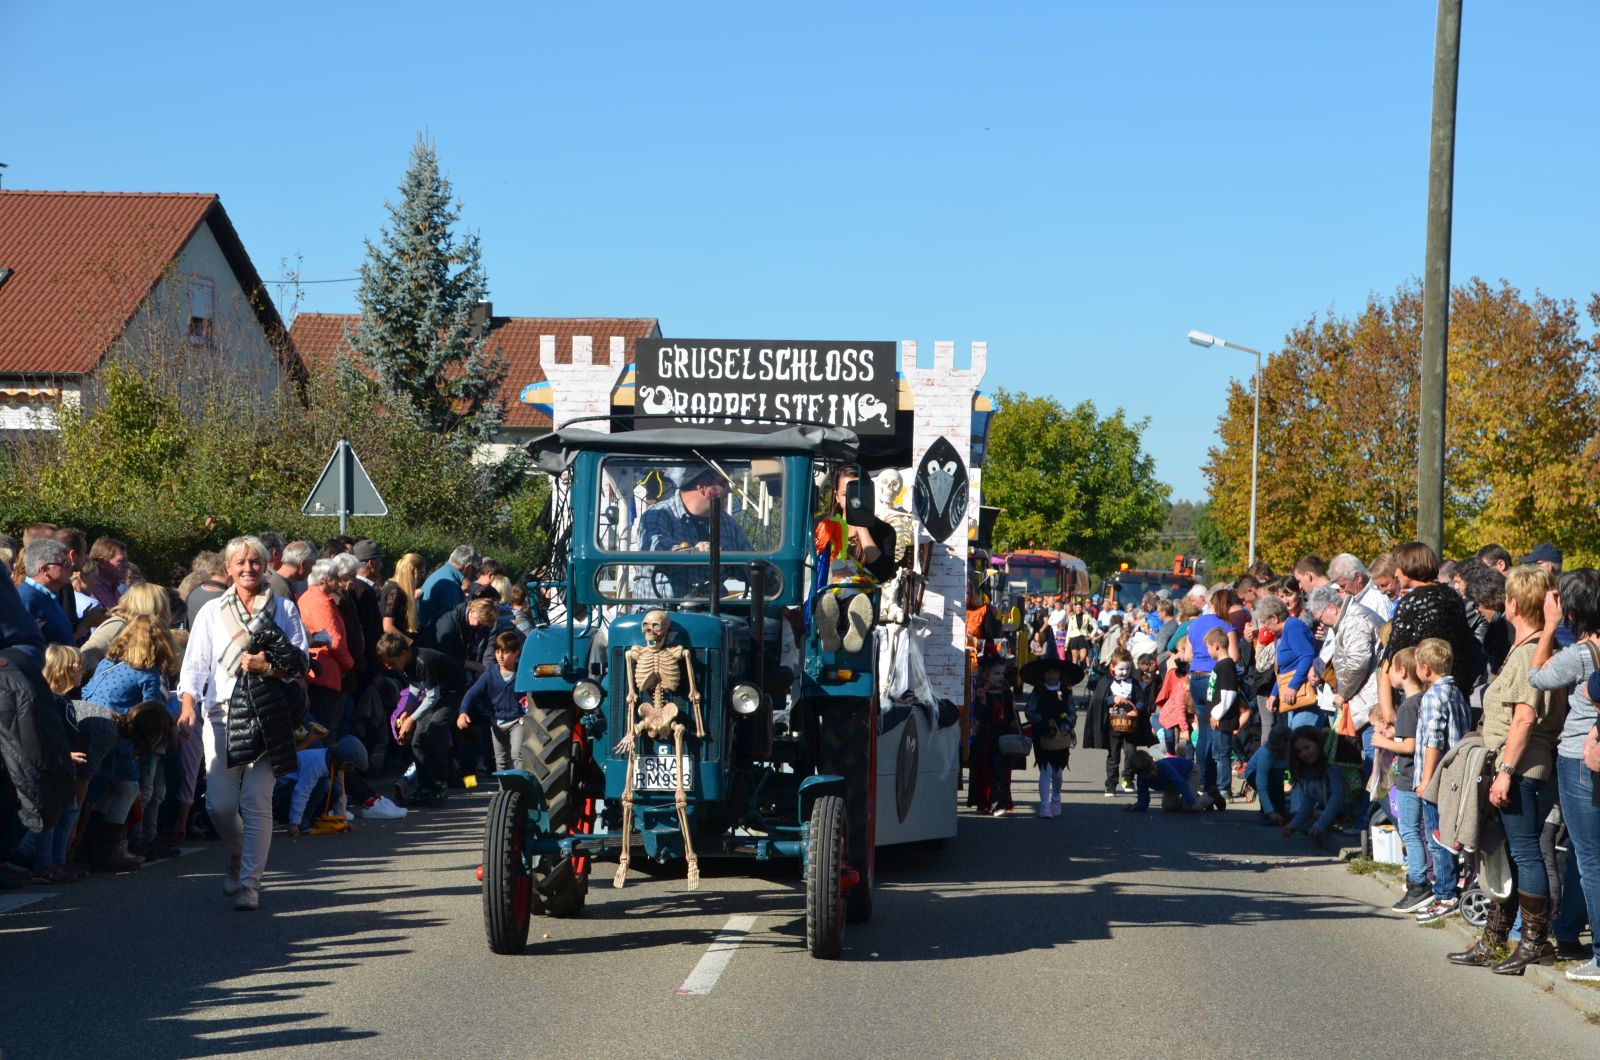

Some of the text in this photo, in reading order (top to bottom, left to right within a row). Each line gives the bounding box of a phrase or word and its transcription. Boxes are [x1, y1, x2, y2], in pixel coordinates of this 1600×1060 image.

[658, 343, 875, 383] GRUSELSCHLOSS
[674, 388, 859, 427] RAPPELSTEIN
[645, 757, 679, 772] SHA
